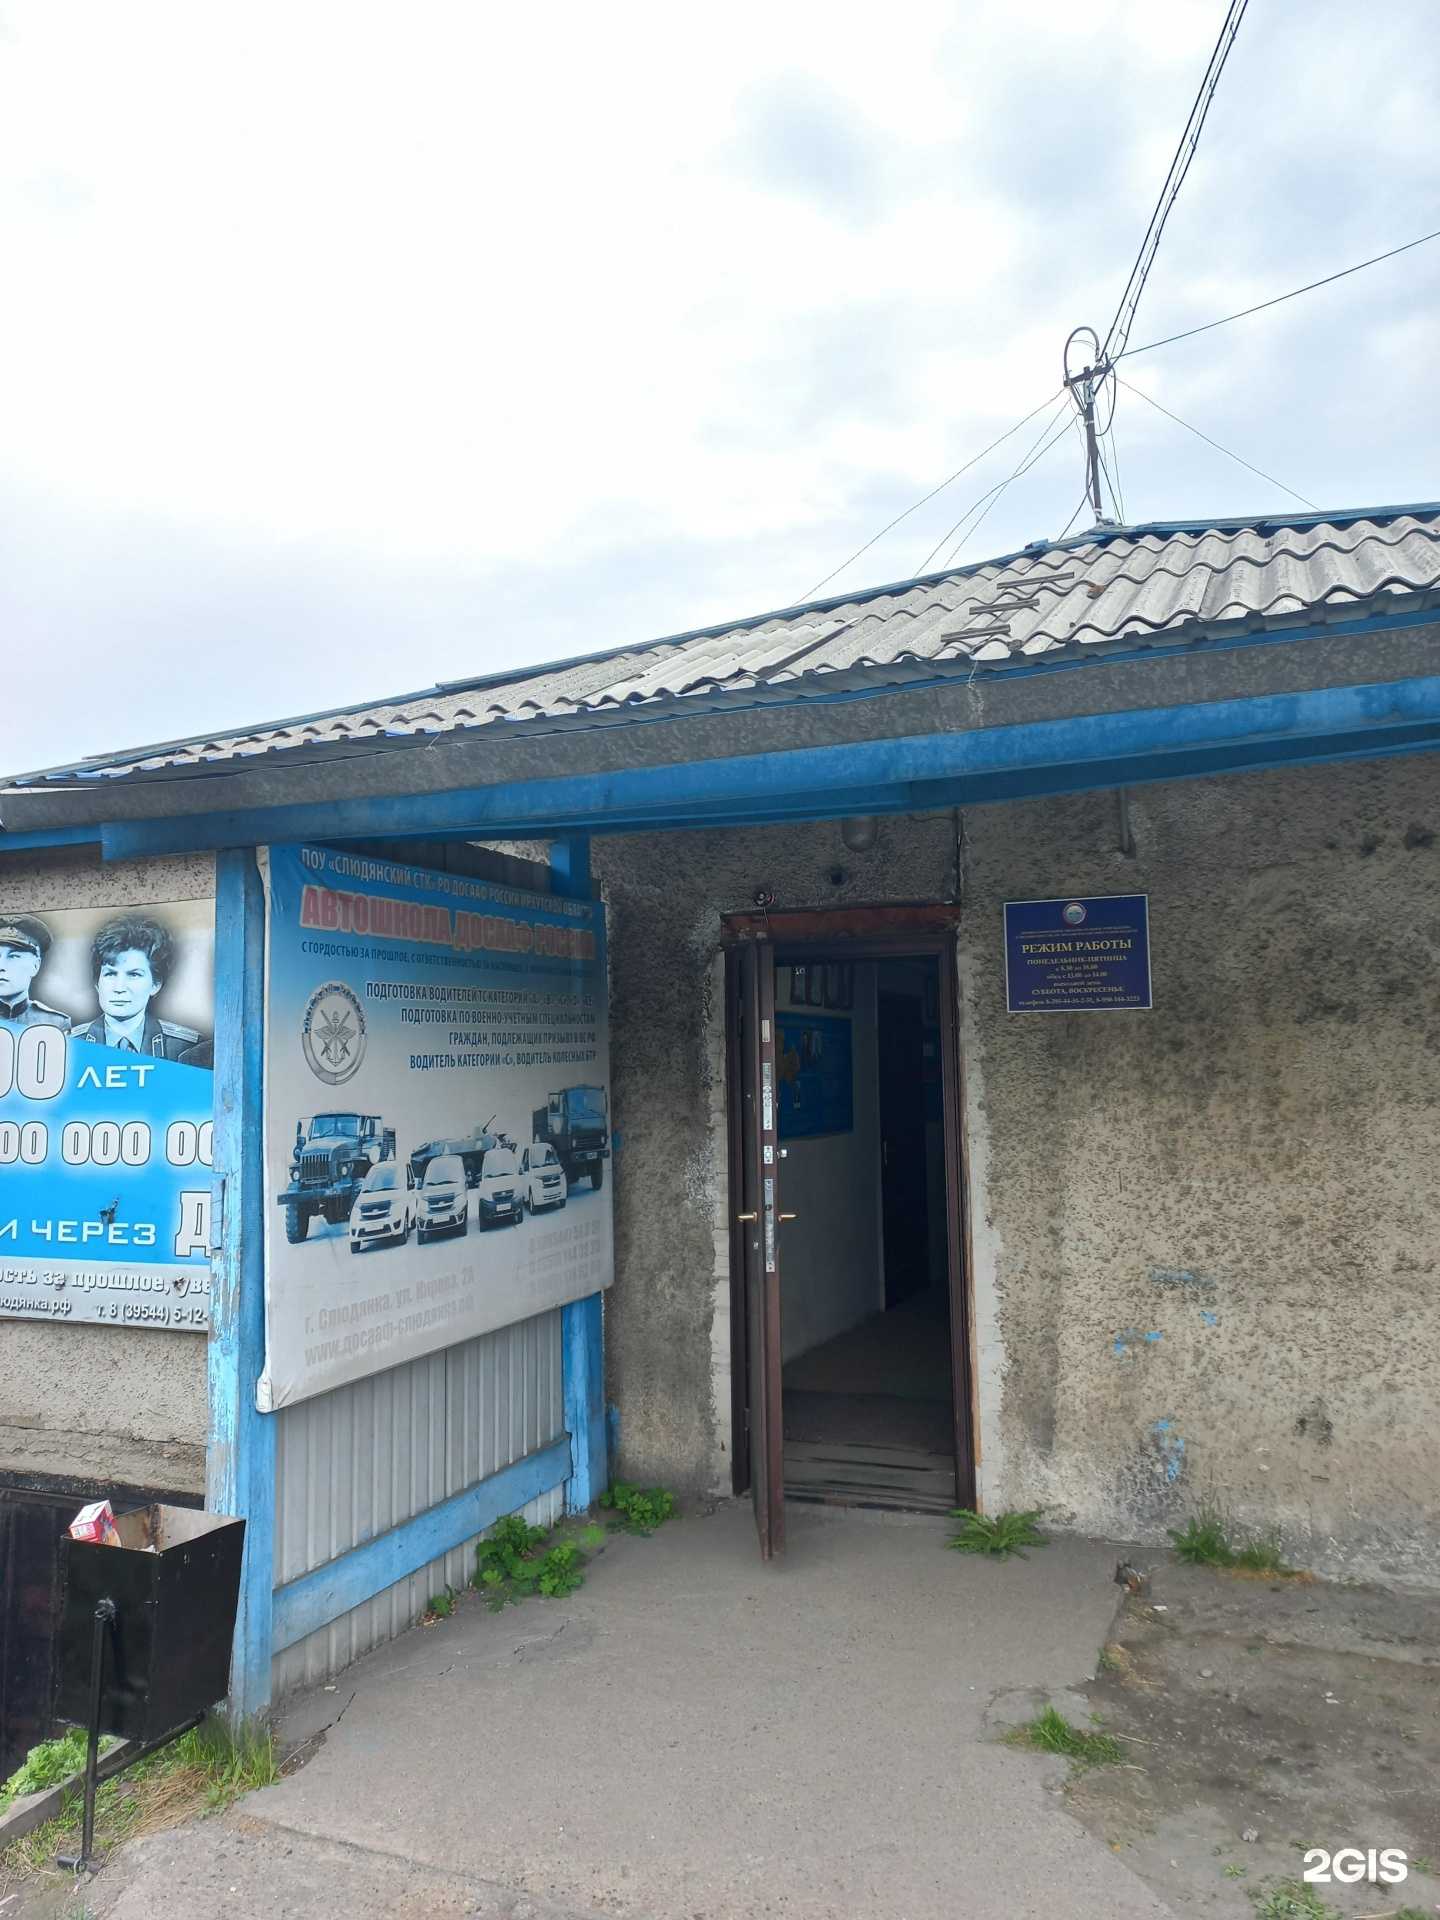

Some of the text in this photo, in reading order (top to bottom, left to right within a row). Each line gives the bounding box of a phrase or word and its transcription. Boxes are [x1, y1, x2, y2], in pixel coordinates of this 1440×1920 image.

[302, 848, 326, 871] ПОУ
[329, 855, 411, 886] «СЛЮДЯНСКИЙ
[299, 884, 451, 946] АВТОШКОЛА
[453, 910, 532, 953] ДОСААФ
[309, 942, 359, 957] ГОРДОСТЬЮ
[360, 949, 370, 958] ЗА
[1022, 938, 1132, 954] РЕЖИМ РАБОТЫ
[366, 982, 428, 1001] ПОДГОТОВКА
[429, 985, 478, 1003] ВОДИТЕЛЕЙ
[401, 1008, 458, 1025] ПОДГОТОВКА
[459, 1010, 471, 1023] ПО
[449, 1032, 490, 1047] ГРАЖДАН,
[491, 1032, 543, 1046] ПОДЛЕЖАЩИХ
[410, 1054, 456, 1071] ВОДИТЕЛЬ
[457, 1053, 501, 1068] КАТЕГОРИИ
[517, 1052, 552, 1067] ВОДИТЕЛЬ
[77, 1065, 155, 1089] ЛЕТ
[62, 1121, 151, 1166] 000
[31, 1219, 157, 1246] ЧЕРЕЗ
[72, 1271, 171, 1294] прошлое,
[110, 1303, 118, 1317] 8
[122, 1304, 169, 1323] (39544)
